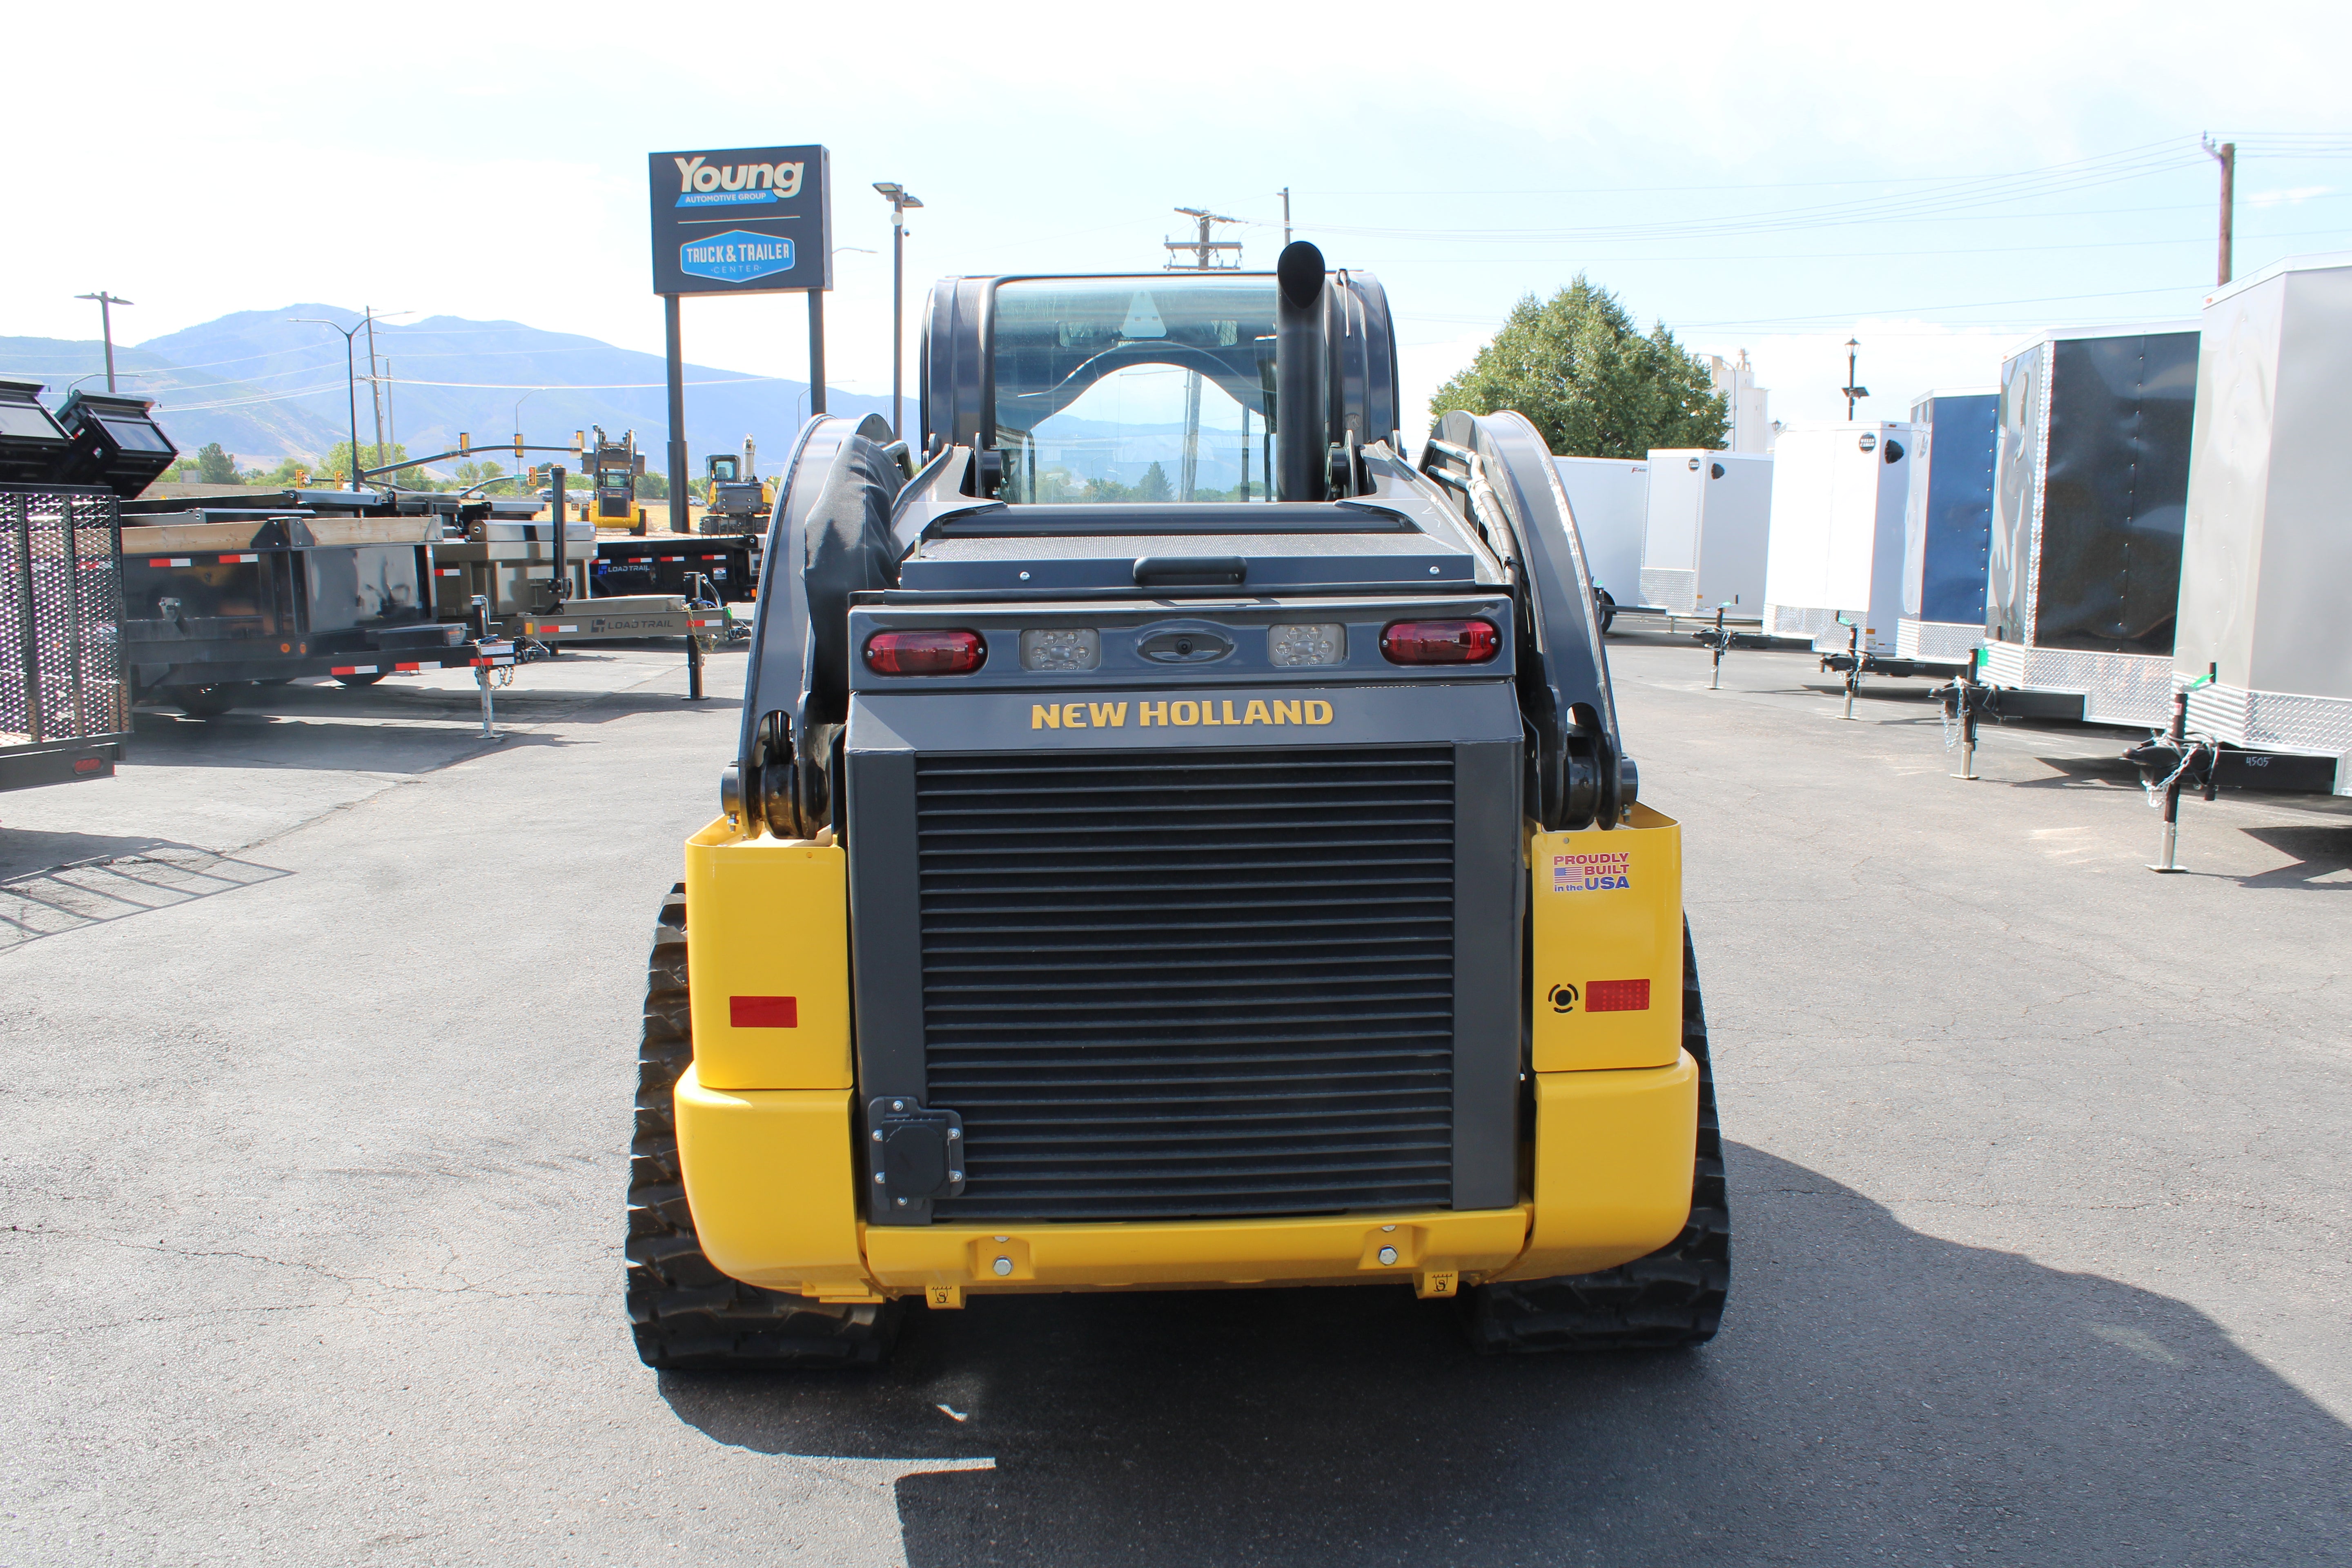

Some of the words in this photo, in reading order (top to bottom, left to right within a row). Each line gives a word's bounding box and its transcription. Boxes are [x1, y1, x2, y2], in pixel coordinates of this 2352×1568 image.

[674, 156, 804, 198] Young
[686, 194, 737, 203] AUTOMOTIVE
[686, 246, 725, 263] TRUCK
[726, 245, 737, 263] &
[738, 243, 789, 262] TRAILER
[713, 265, 760, 274] CENTER
[608, 621, 639, 629] LOAD
[1032, 702, 1128, 729] NEW
[1139, 700, 1334, 726] HOLLAND
[2246, 756, 2274, 767] 4505
[1554, 853, 1629, 865] PROUDLY
[1584, 864, 1630, 875] BUILT
[1585, 876, 1630, 890] USA
